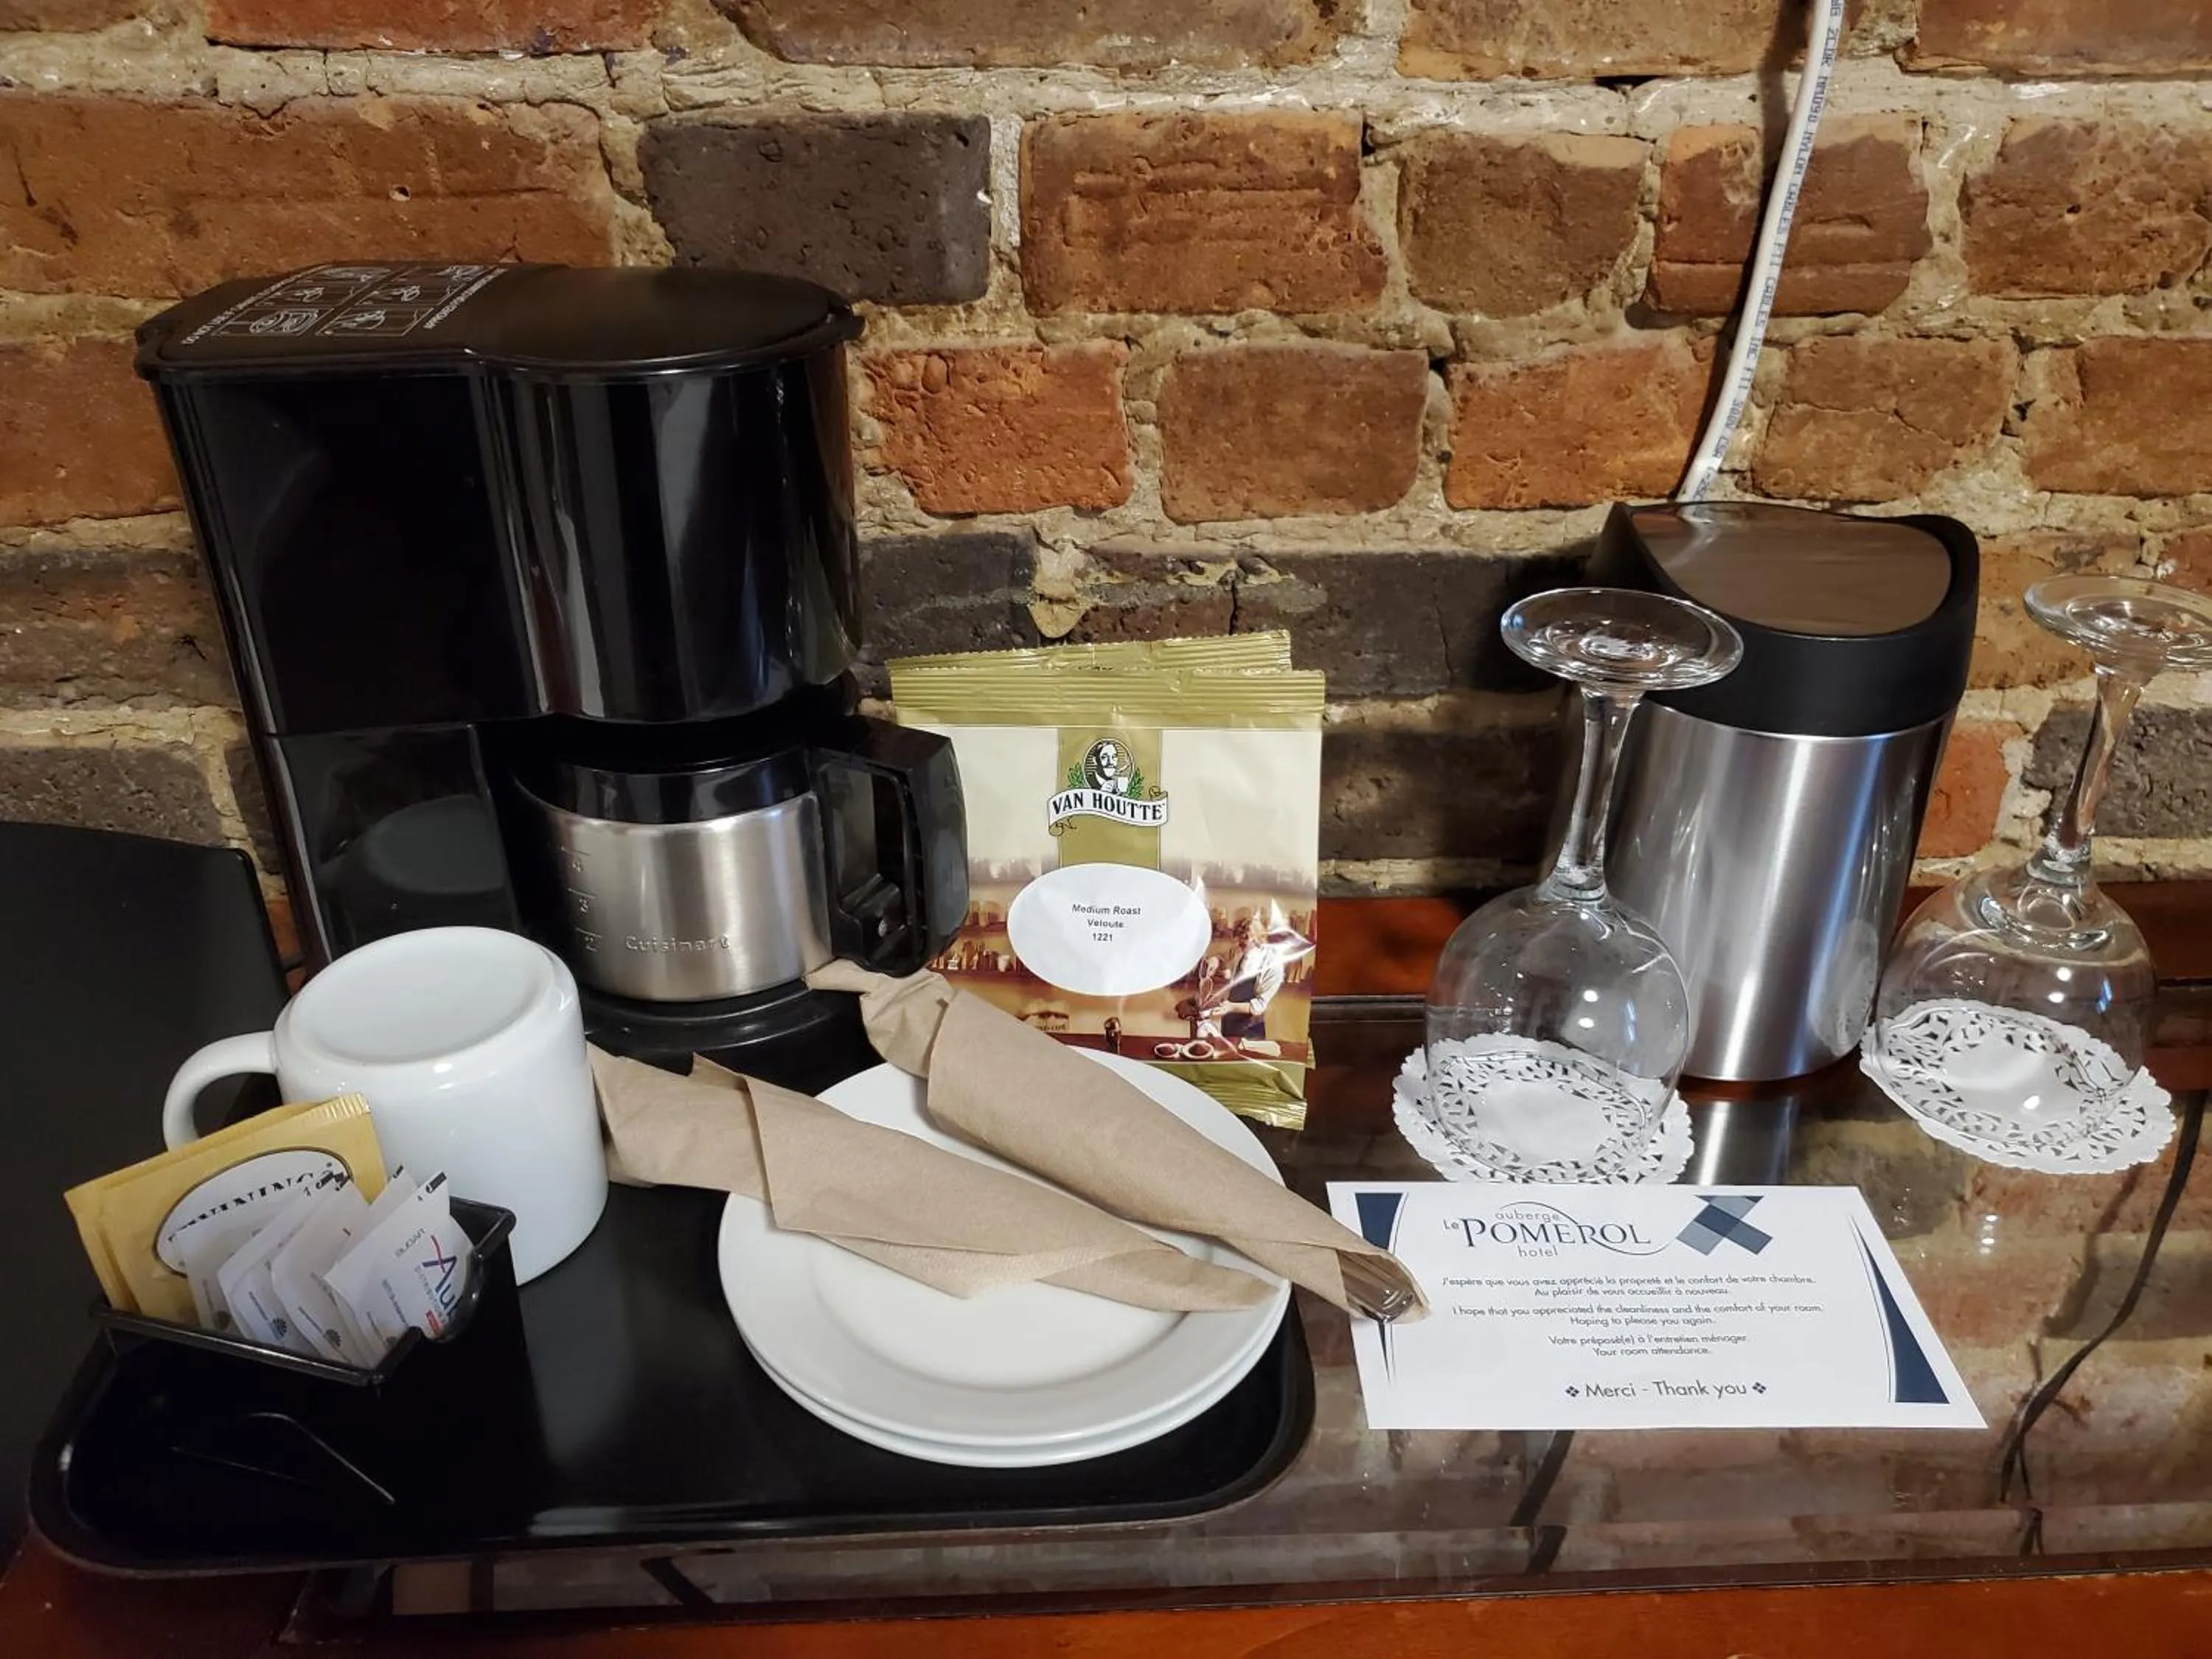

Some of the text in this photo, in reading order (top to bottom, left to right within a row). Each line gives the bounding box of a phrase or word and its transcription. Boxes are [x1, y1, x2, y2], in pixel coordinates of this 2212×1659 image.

[1052, 793, 1163, 821] VAN HOUTTE
[1072, 904, 1141, 915] Medium Roast
[625, 933, 731, 952] Cuisinart
[1092, 933, 1113, 942] 1221
[1495, 1209, 1560, 1222] auberge
[1442, 1217, 1651, 1248] Le POMEROL
[1517, 1245, 1558, 1257] hotel
[1442, 1277, 1482, 1287] J'espère
[1559, 1276, 1603, 1287] apprécié
[1619, 1276, 1660, 1287] propreté
[1688, 1276, 1723, 1284] confort
[1770, 1274, 1816, 1284] chambre.
[1552, 1288, 1582, 1298] plaisir
[1627, 1287, 1672, 1295] accueillir
[1458, 1305, 1485, 1316] hope
[1488, 1306, 1508, 1315] that
[1510, 1308, 1530, 1317] you
[1532, 1304, 1593, 1316] appreciated
[1596, 1304, 1613, 1313] the
[1615, 1304, 1669, 1314] cleanliness
[1672, 1304, 1692, 1313] and
[1695, 1304, 1711, 1313] the
[1714, 1304, 1753, 1312] comfort
[1768, 1306, 1791, 1315] your
[1570, 1317, 1609, 1327] Hoping
[1625, 1317, 1658, 1327] please
[1660, 1318, 1678, 1326] you
[1682, 1316, 1717, 1326] again.
[1548, 1335, 1576, 1345] Votre
[1647, 1334, 1699, 1343] l'entretien
[1593, 1347, 1617, 1356] Your
[1651, 1346, 1711, 1355] attendance.
[1585, 1382, 1636, 1397] Merci
[1652, 1380, 1709, 1396] Thank
[1713, 1383, 1747, 1399] you
